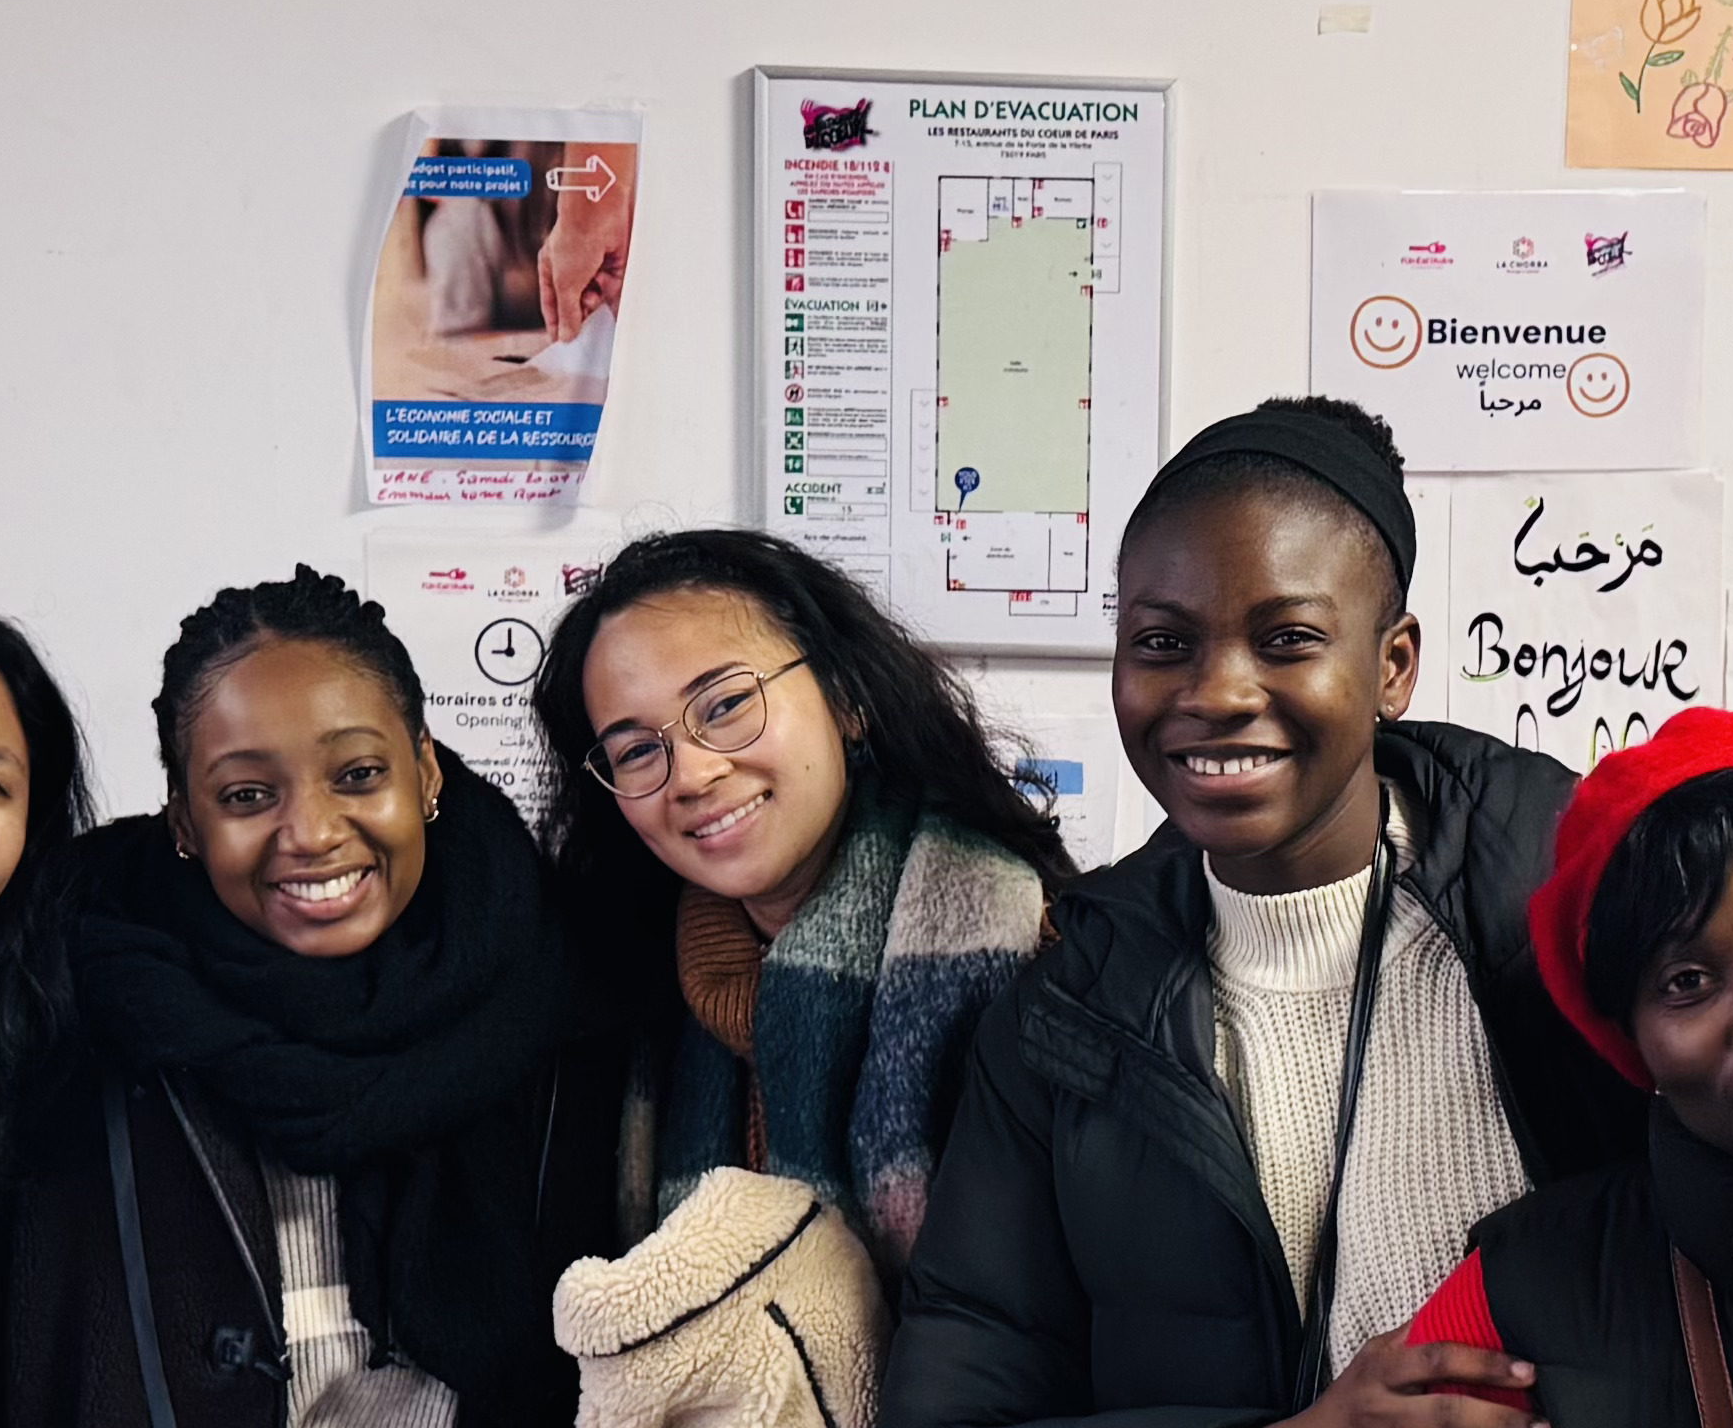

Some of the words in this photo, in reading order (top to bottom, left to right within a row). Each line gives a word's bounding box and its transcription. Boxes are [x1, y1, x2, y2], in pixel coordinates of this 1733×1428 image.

[909, 99, 966, 118] PLAN
[974, 100, 1139, 122] D'EVACUATION
[928, 127, 945, 137] LES
[947, 127, 1017, 138] RESTAURANTS
[1020, 129, 1035, 138] DU
[1038, 129, 1072, 139] COEUR
[1075, 130, 1087, 139] DE
[1091, 130, 1119, 140] PARIS
[785, 159, 838, 171] INCENDIE
[450, 179, 482, 190] notre
[485, 179, 521, 193] projet
[785, 297, 859, 311] ÉVACUATION
[1428, 318, 1606, 344] Bienvenue
[1456, 358, 1566, 379] welcome
[473, 410, 532, 425] SOCIALE
[535, 410, 553, 425] ET
[387, 429, 461, 445] SOLIDAIRE
[477, 431, 497, 445] DE
[500, 431, 519, 445] LA
[785, 483, 842, 494] ACCIDENT
[456, 713, 523, 730] Opening
